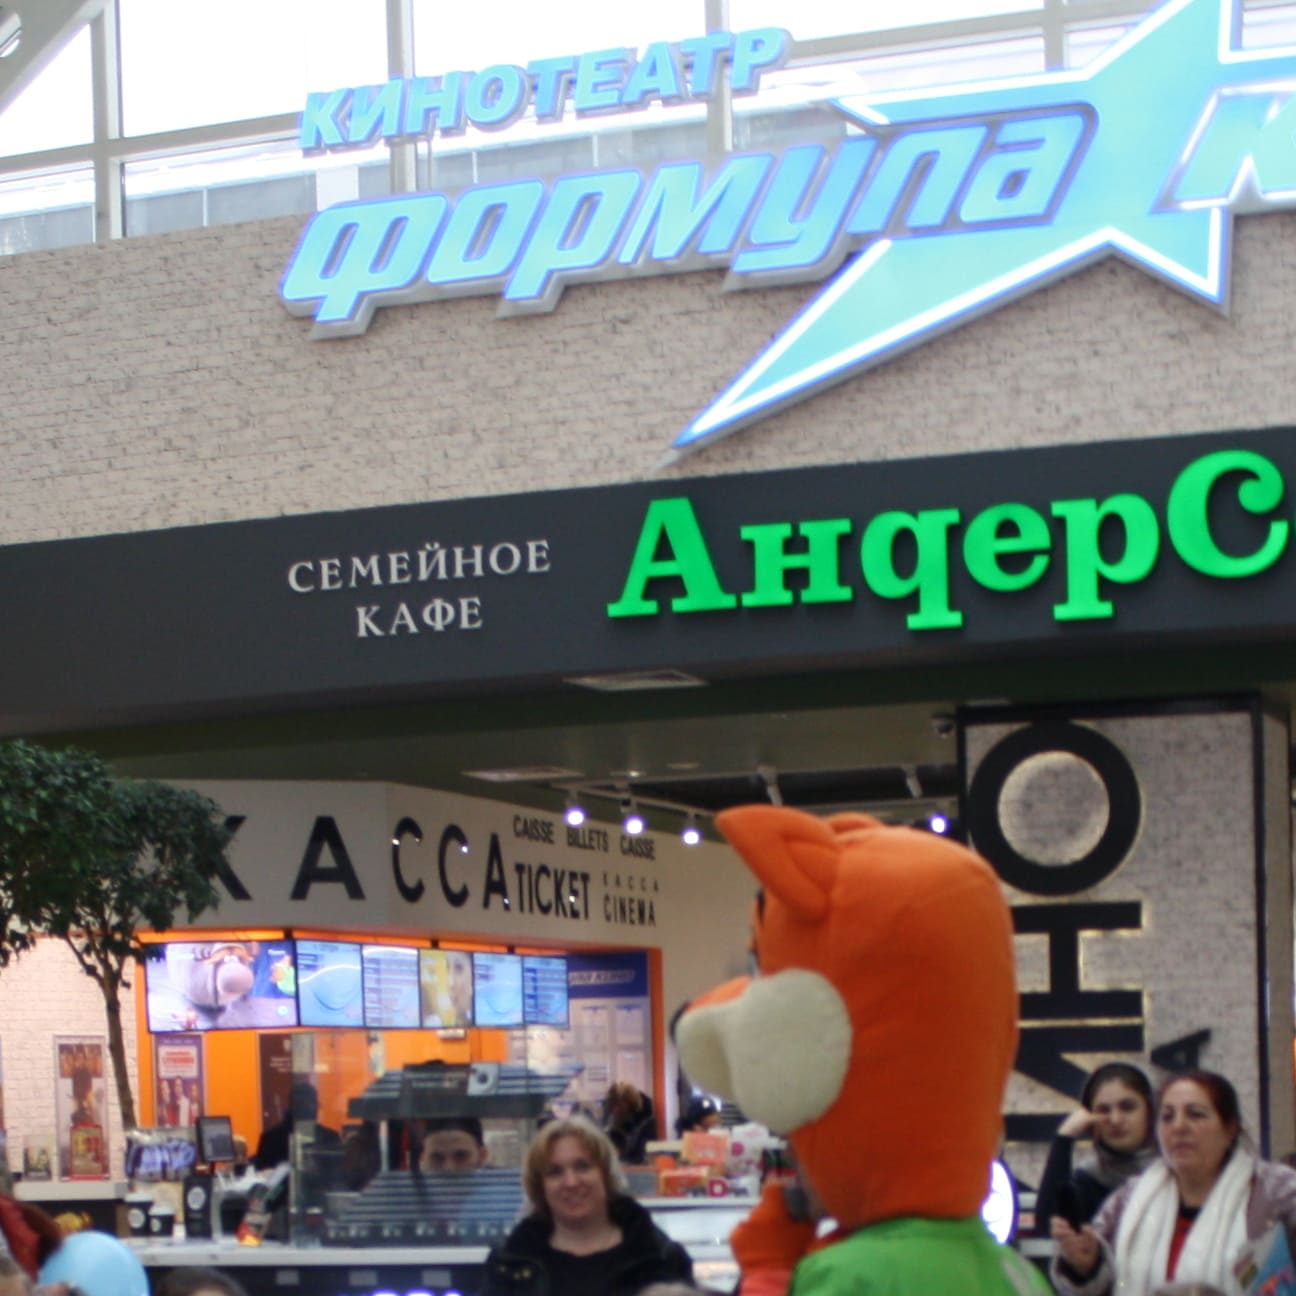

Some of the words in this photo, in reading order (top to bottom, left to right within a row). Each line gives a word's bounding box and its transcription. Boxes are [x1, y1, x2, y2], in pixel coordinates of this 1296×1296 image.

[298, 27, 787, 150] КИНОТЕАТР
[286, 537, 552, 594] СЕМЕЙНОЕ
[354, 594, 484, 640] КАФЕ
[513, 814, 554, 845] CAISSE
[566, 826, 609, 853] BILLETS
[619, 833, 656, 861] CAISSE
[514, 861, 590, 921] TICKET
[604, 894, 657, 928] CINEMA
